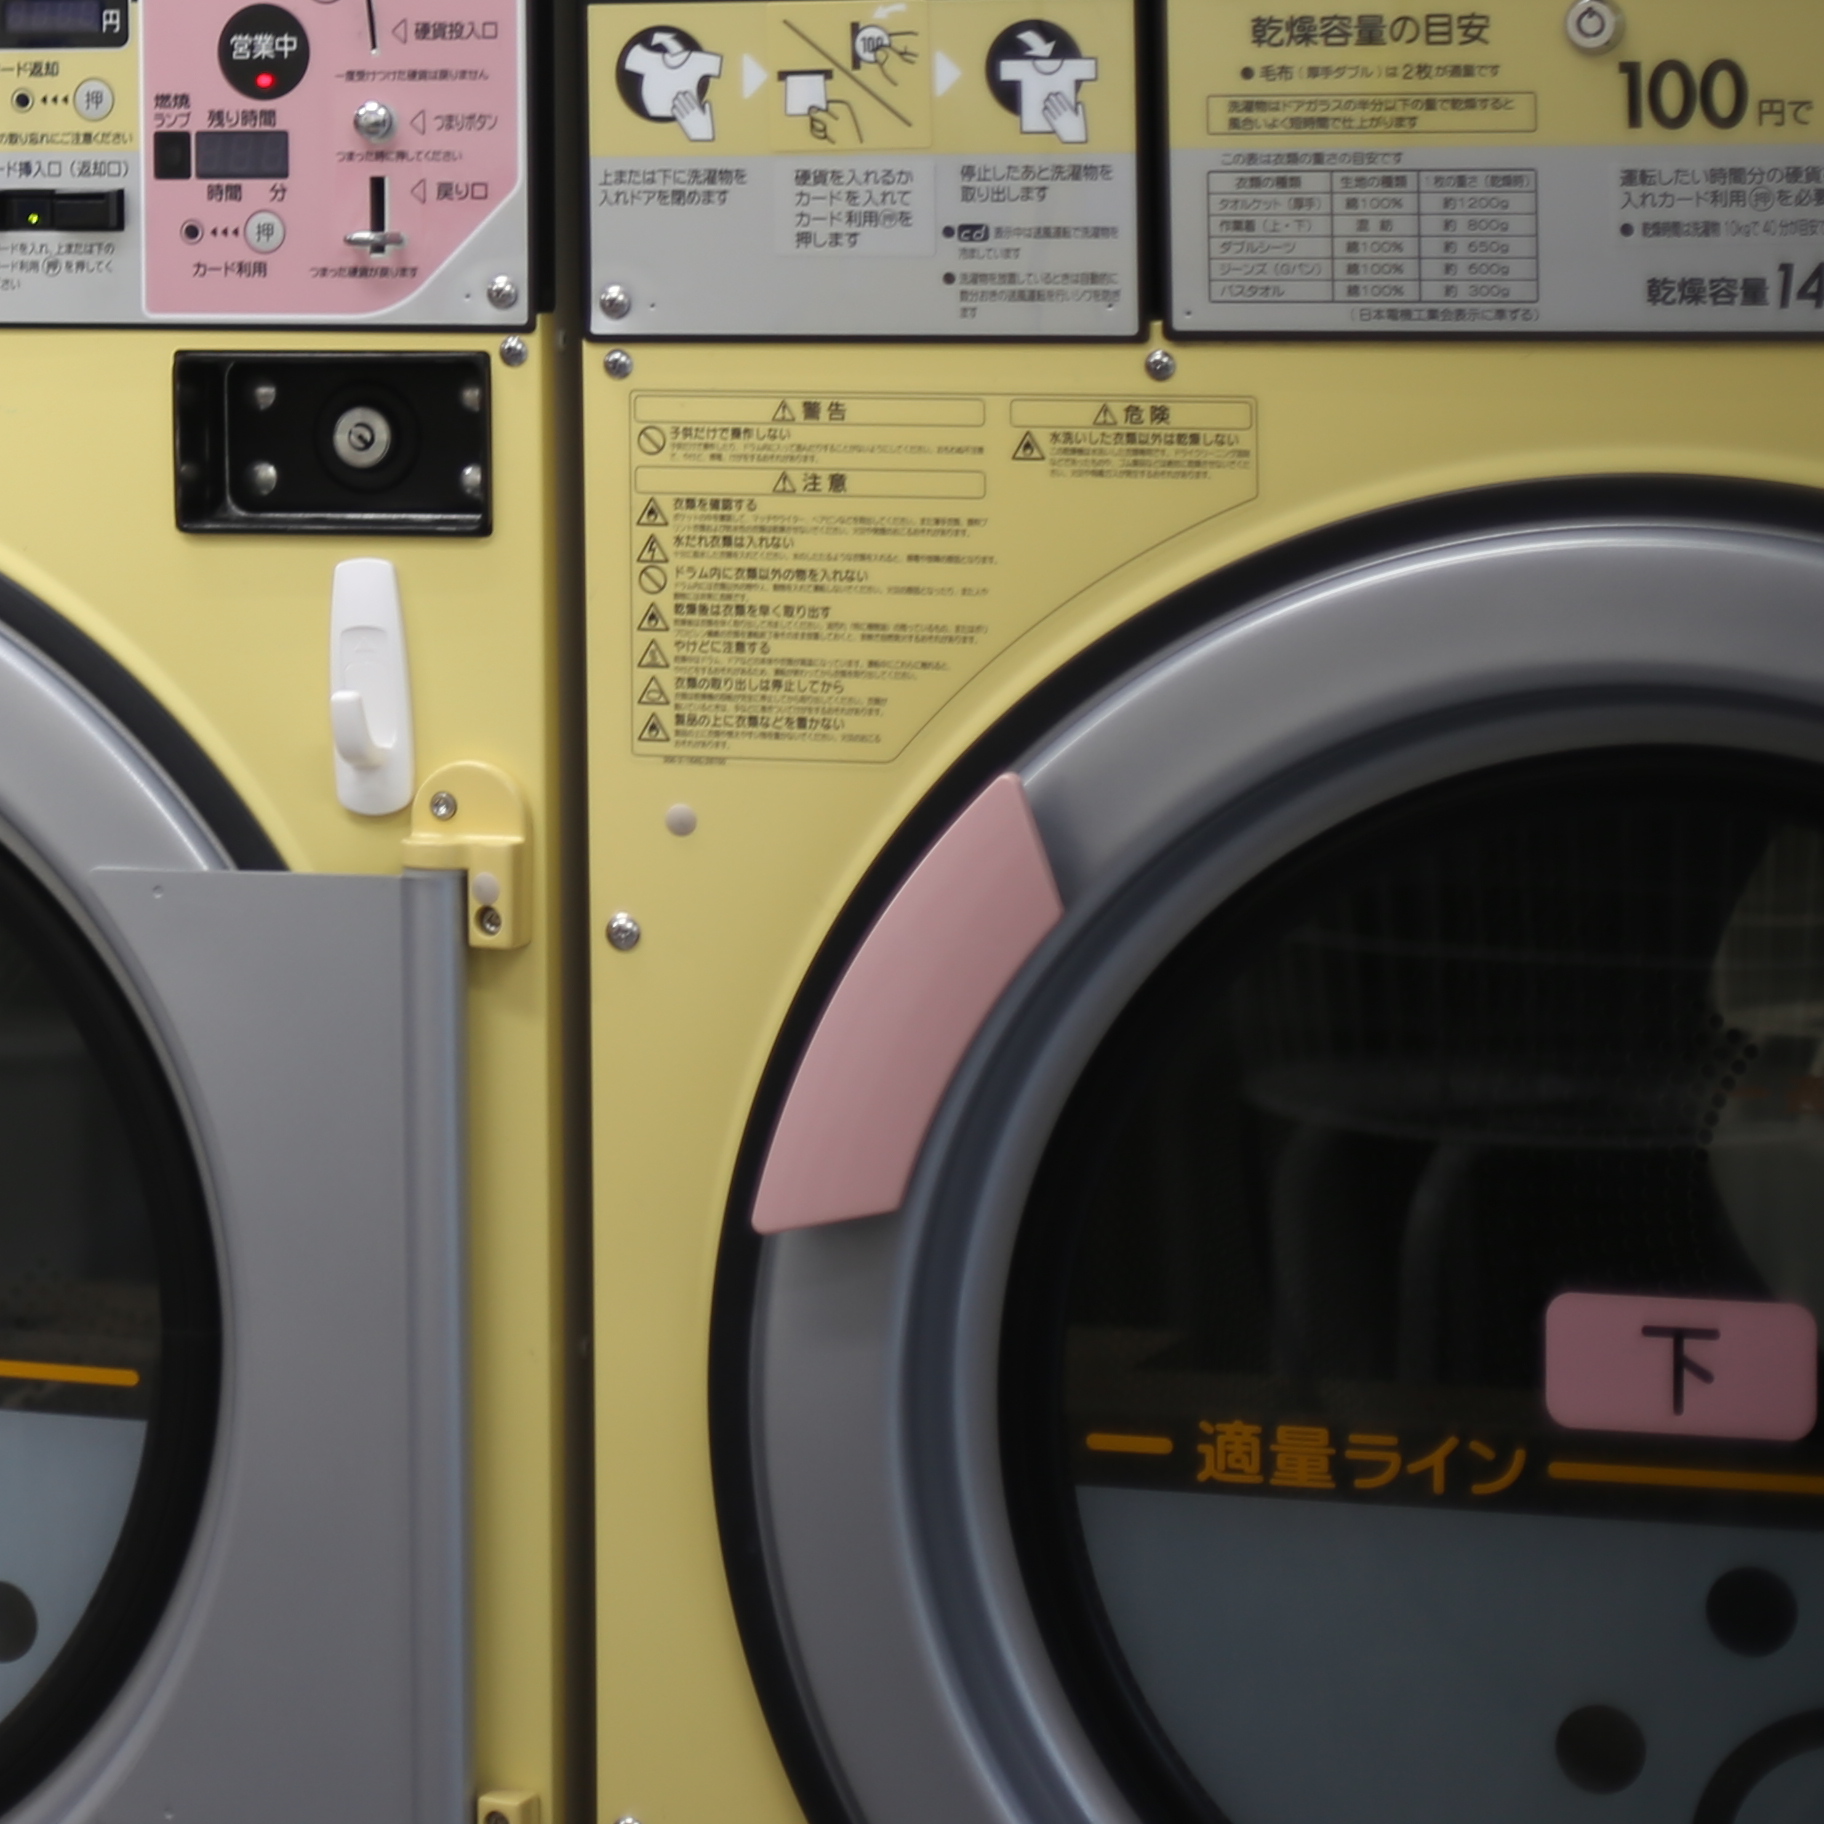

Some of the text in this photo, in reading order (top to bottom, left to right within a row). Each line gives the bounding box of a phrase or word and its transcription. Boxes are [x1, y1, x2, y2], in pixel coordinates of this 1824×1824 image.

[103, 11, 120, 32] 円
[414, 21, 497, 40] 硬貨投入口
[1251, 12, 1490, 47] 乾燥容量の目安
[229, 33, 297, 60] 営業中
[83, 90, 104, 111] 押
[154, 93, 190, 110] 燃焼
[153, 112, 191, 127] ランプ
[208, 110, 276, 127] 残り時間
[433, 112, 497, 131] つまりボタン
[599, 168, 747, 186] 上または下に洗濯物を
[795, 169, 913, 186] 硬貨を入れるか
[960, 164, 1114, 182] 停止したあと洗濯物を
[208, 183, 287, 202] 時間 分
[436, 182, 488, 201] 戻り口
[599, 189, 729, 206] 入れドアを閉めます
[960, 185, 1048, 203] 取り出します
[256, 222, 275, 241] 押
[795, 231, 860, 248] 押します
[193, 261, 267, 277] カード利用
[802, 400, 847, 423] 警告
[1124, 405, 1170, 425] 危険
[670, 426, 791, 442] 子供だけで操作しない
[1050, 432, 1239, 446] 水洗いした衣類以外は乾燥しない
[803, 473, 847, 493] 注意
[673, 498, 757, 512] 衣類を確認する
[673, 535, 793, 549] 水だれ衣類は入れない
[674, 603, 832, 619] 乾燥後は衣類を早く取り出す
[674, 641, 771, 654] やけどに注意する
[674, 677, 844, 694] 衣類の取り出しは停止してから
[1642, 1325, 1720, 1415] 下
[1196, 1420, 1527, 1495] 適量ライン
